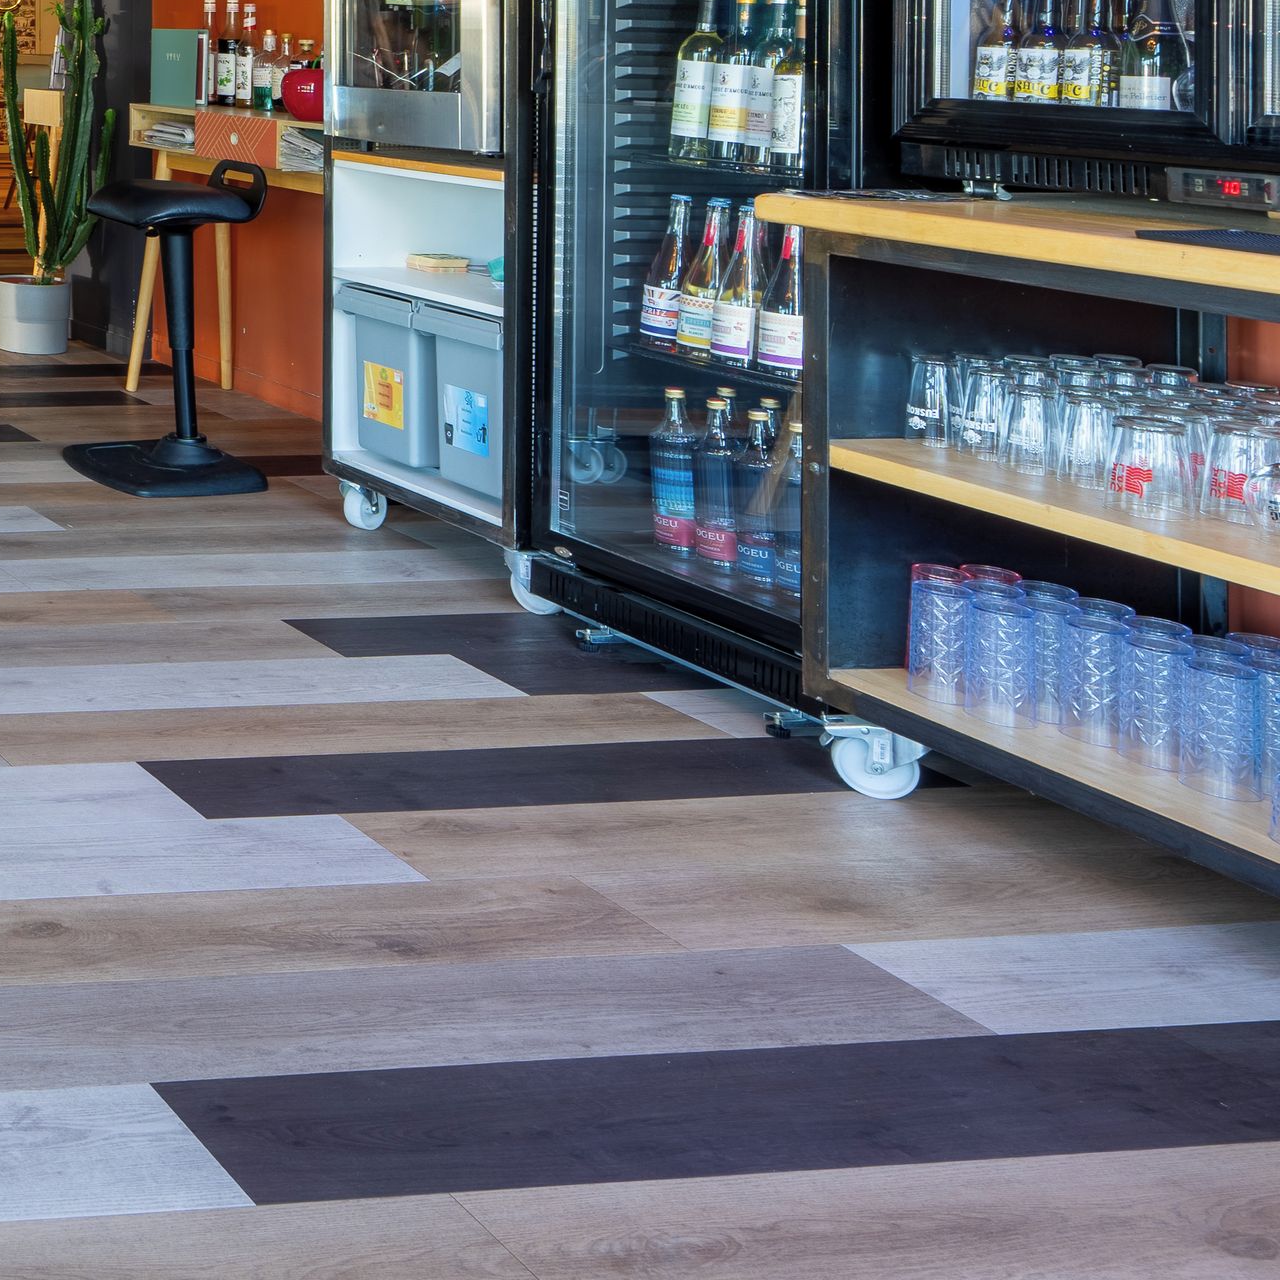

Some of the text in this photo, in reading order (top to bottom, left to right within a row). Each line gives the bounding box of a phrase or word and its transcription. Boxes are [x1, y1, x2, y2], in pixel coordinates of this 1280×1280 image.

[1016, 80, 1050, 95] SHUC
[1222, 180, 1241, 195] 10
[696, 528, 725, 542] OGEU
[737, 544, 769, 559] OGEU
